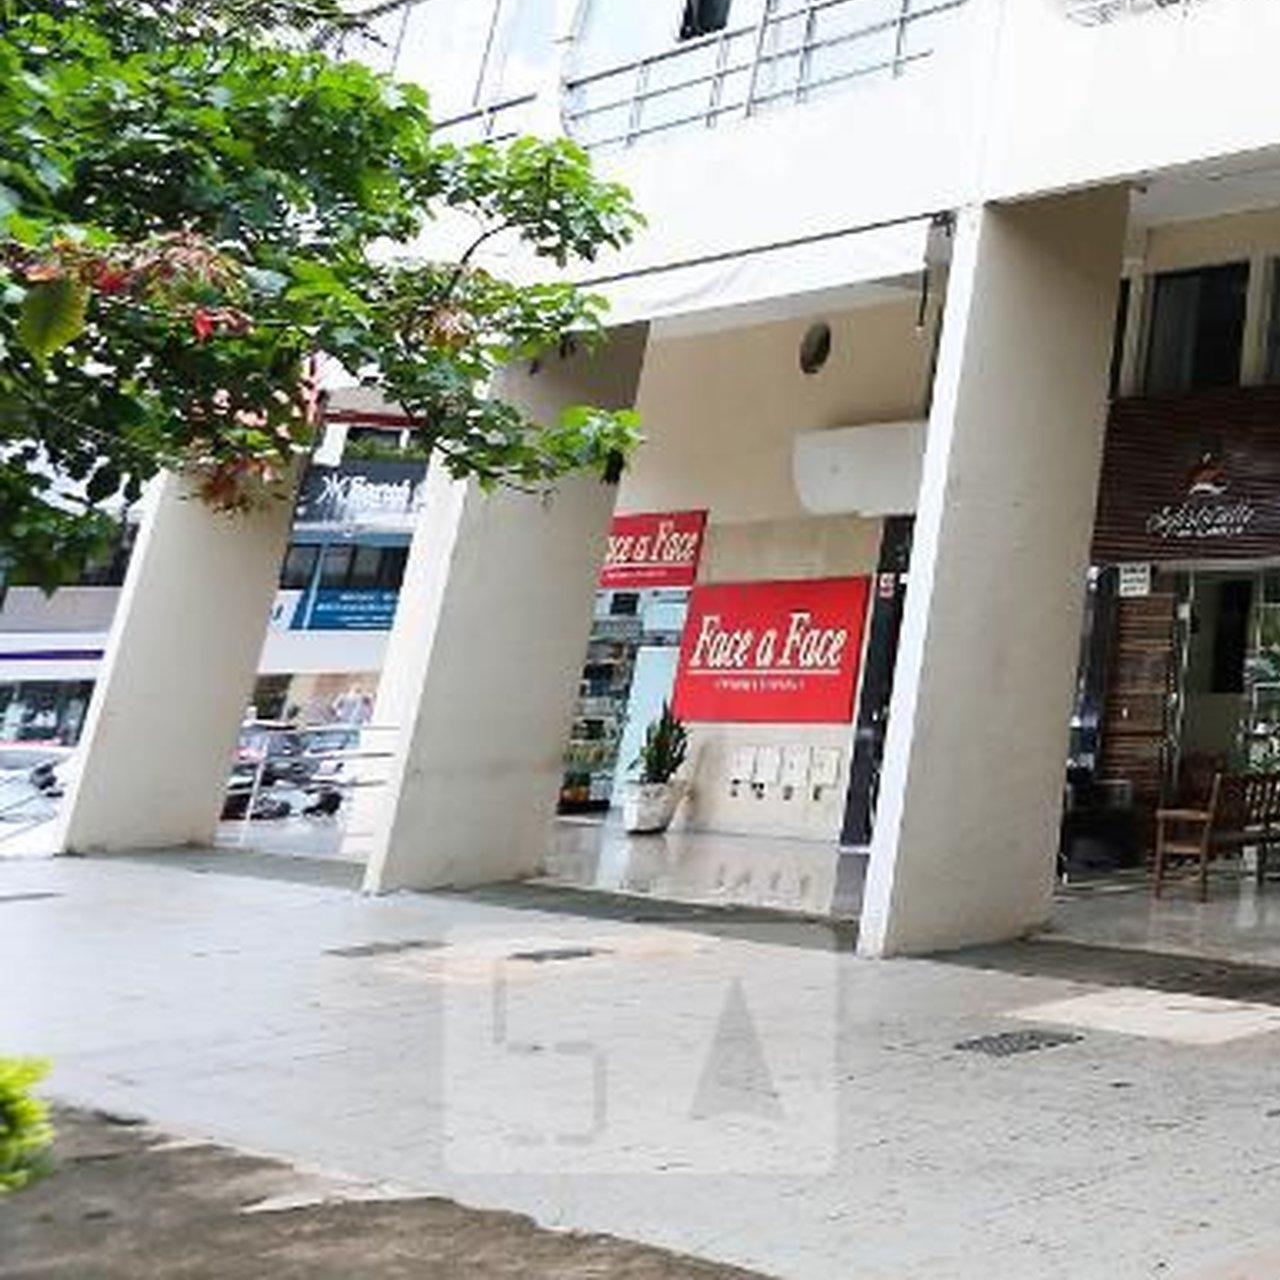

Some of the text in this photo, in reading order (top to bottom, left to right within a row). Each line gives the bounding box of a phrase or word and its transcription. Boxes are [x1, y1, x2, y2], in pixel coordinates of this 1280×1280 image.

[650, 521, 698, 561] Face
[690, 615, 752, 668] Face
[777, 612, 847, 668] Face
